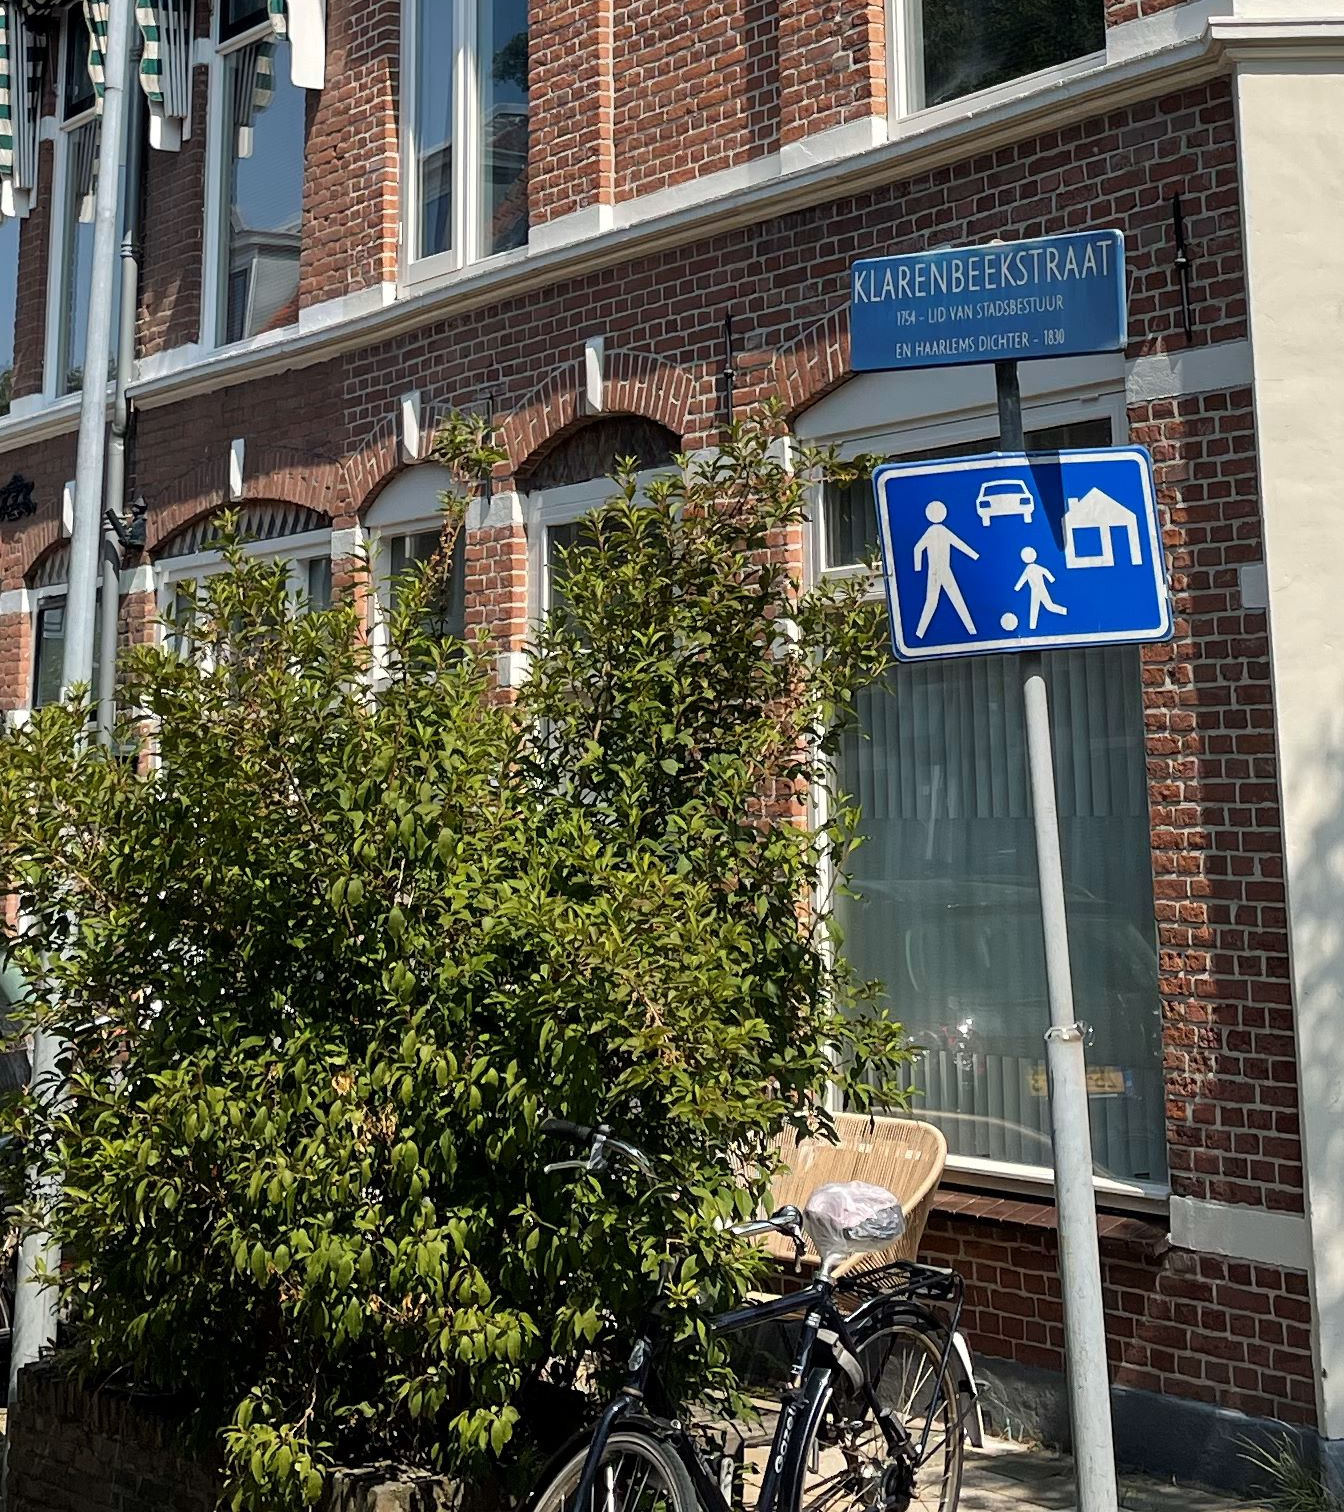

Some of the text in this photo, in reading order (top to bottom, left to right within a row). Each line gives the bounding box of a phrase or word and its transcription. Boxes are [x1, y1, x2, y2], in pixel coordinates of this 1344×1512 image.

[854, 240, 1112, 304] KLARENBEEKSTRAAT
[896, 310, 916, 326] 1754
[928, 307, 946, 324] LID
[949, 304, 973, 321] VAN
[976, 294, 1064, 319] STADSBESTUUR
[896, 342, 911, 359] EN
[916, 336, 975, 357] HAARLEMS
[979, 331, 1030, 353] DICHTER
[1044, 328, 1065, 346] 1830
